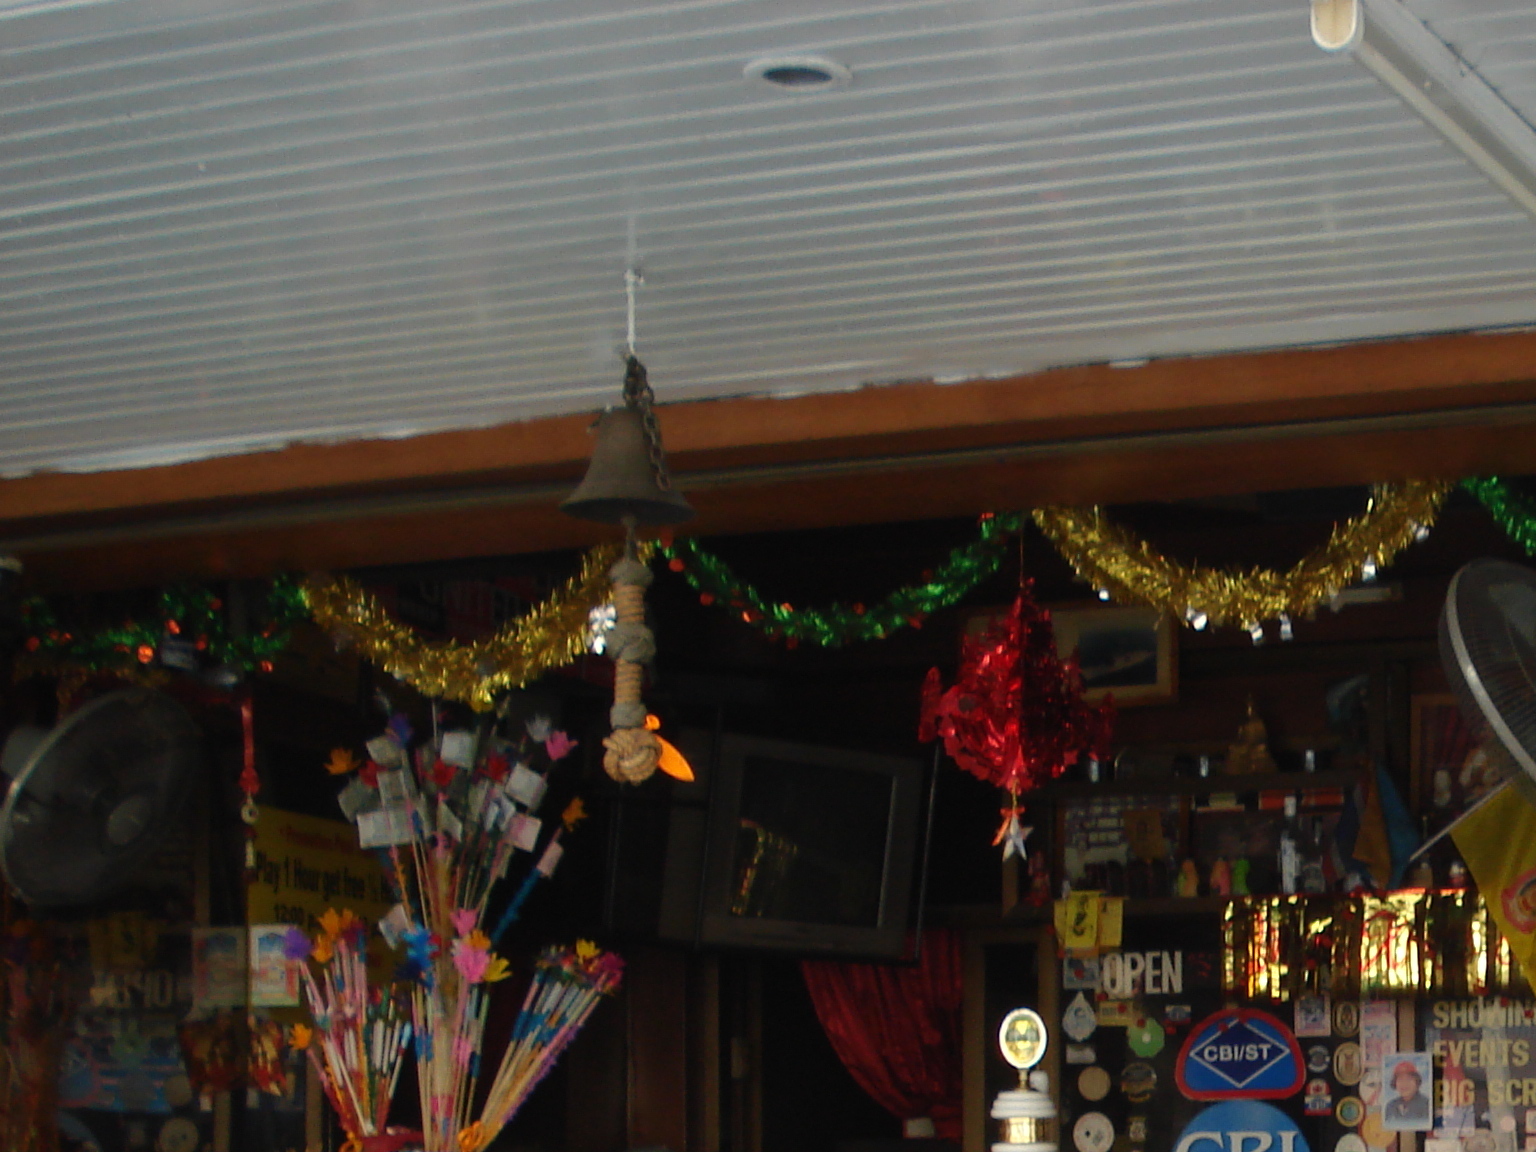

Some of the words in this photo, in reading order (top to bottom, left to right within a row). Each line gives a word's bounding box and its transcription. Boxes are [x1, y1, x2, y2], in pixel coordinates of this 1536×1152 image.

[1103, 951, 1183, 995] OPEN
[1204, 1042, 1271, 1062] CBI/ST
[1433, 1039, 1531, 1068] EVENTS
[1434, 1078, 1476, 1108] BIG
